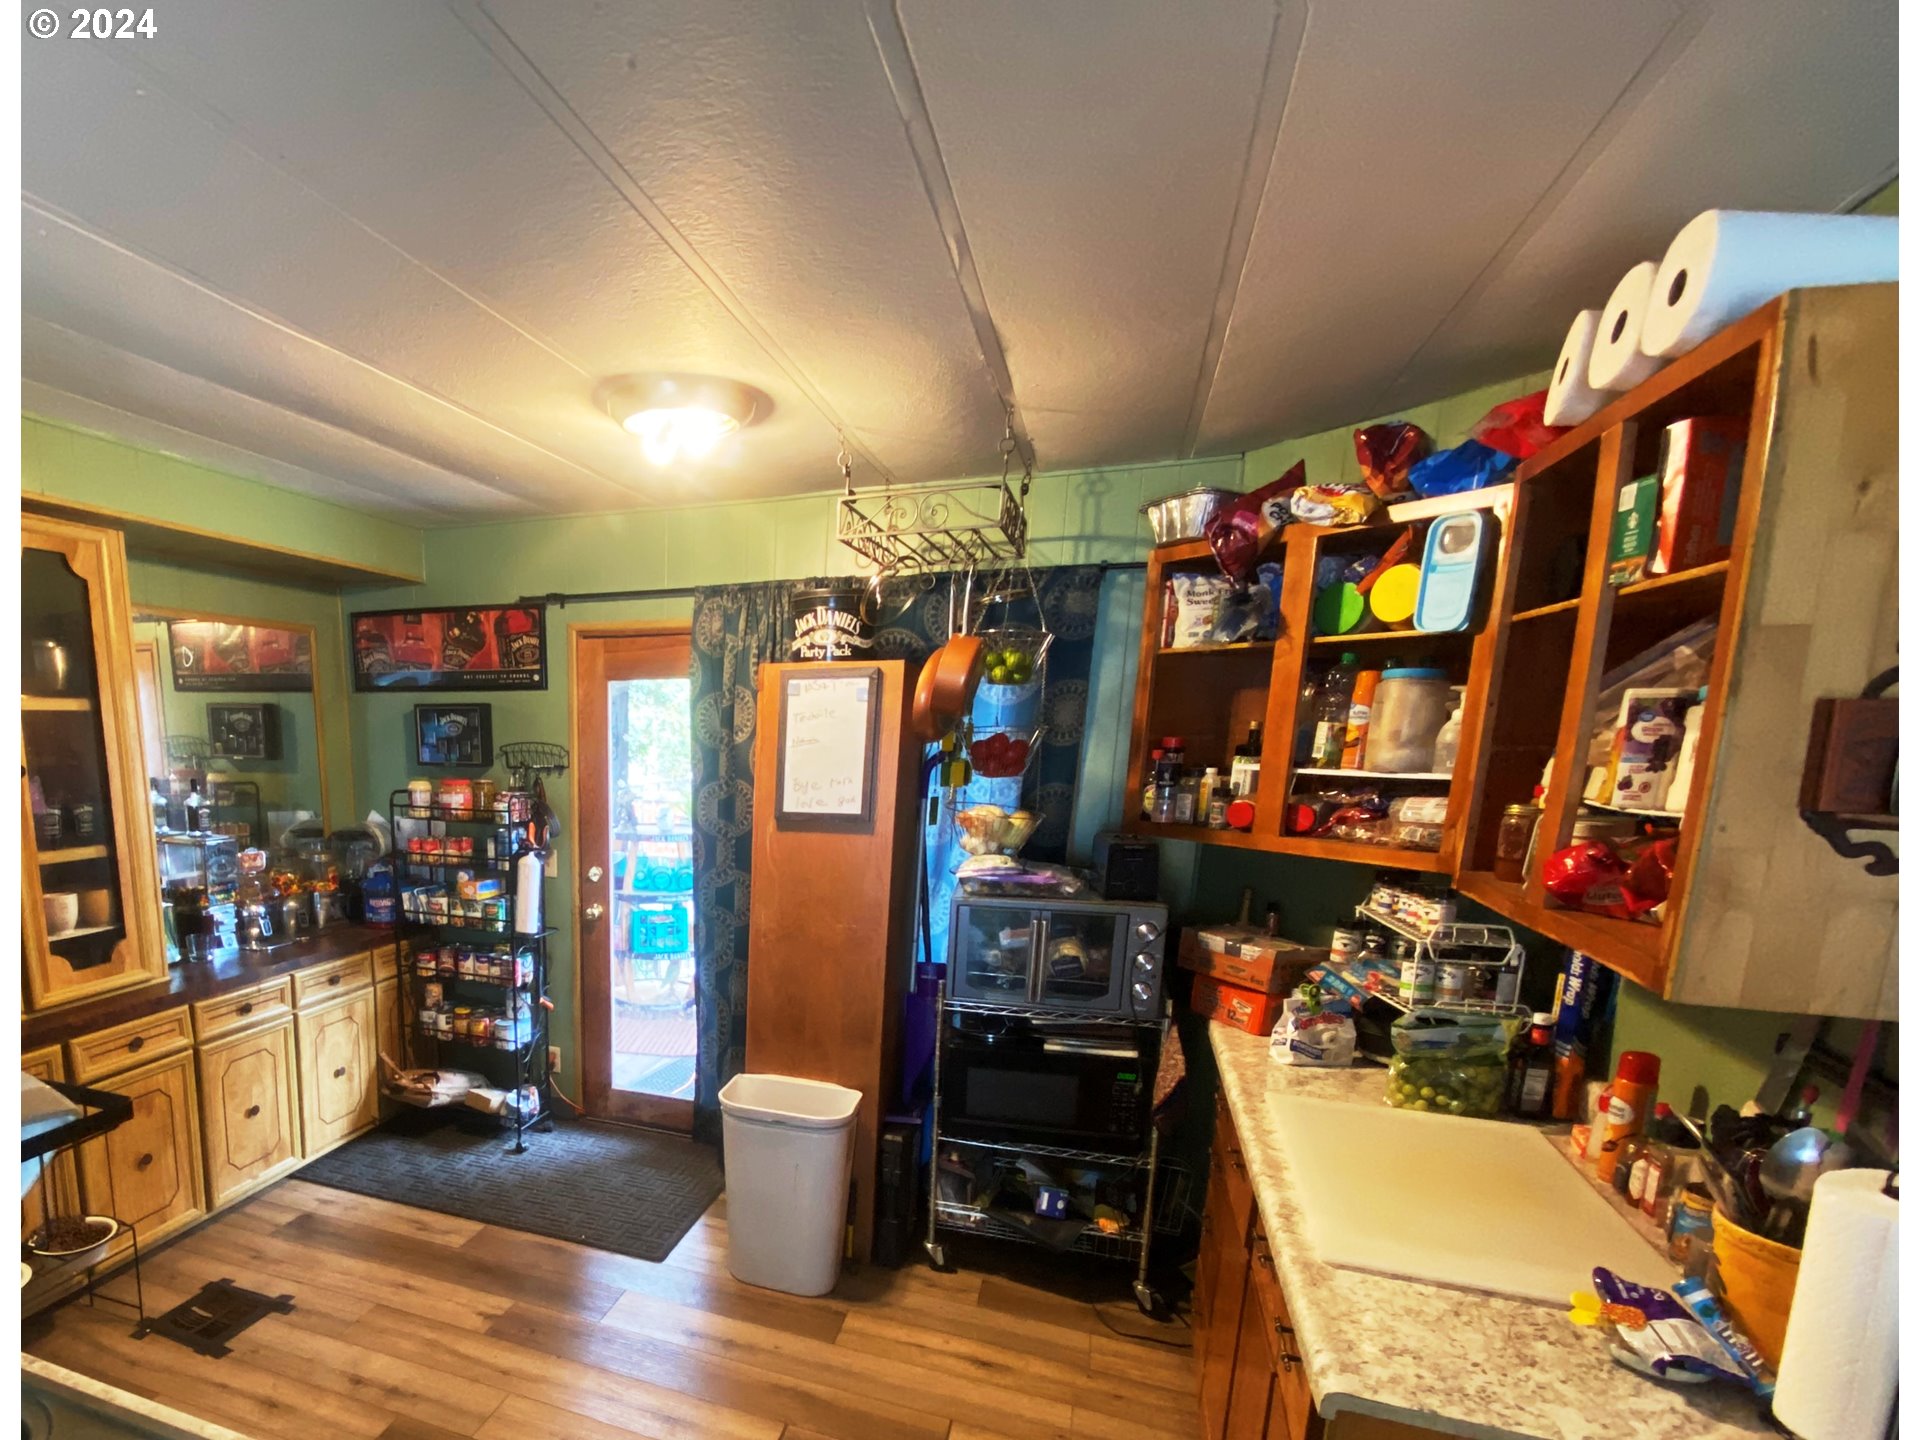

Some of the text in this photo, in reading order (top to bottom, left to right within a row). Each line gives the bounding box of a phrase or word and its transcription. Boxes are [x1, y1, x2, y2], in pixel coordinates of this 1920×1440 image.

[1185, 588, 1214, 598] Monk
[794, 605, 863, 637] JACK DANIEL'S
[800, 643, 852, 660] Party Pack
[1562, 976, 1583, 1006] Wrap
